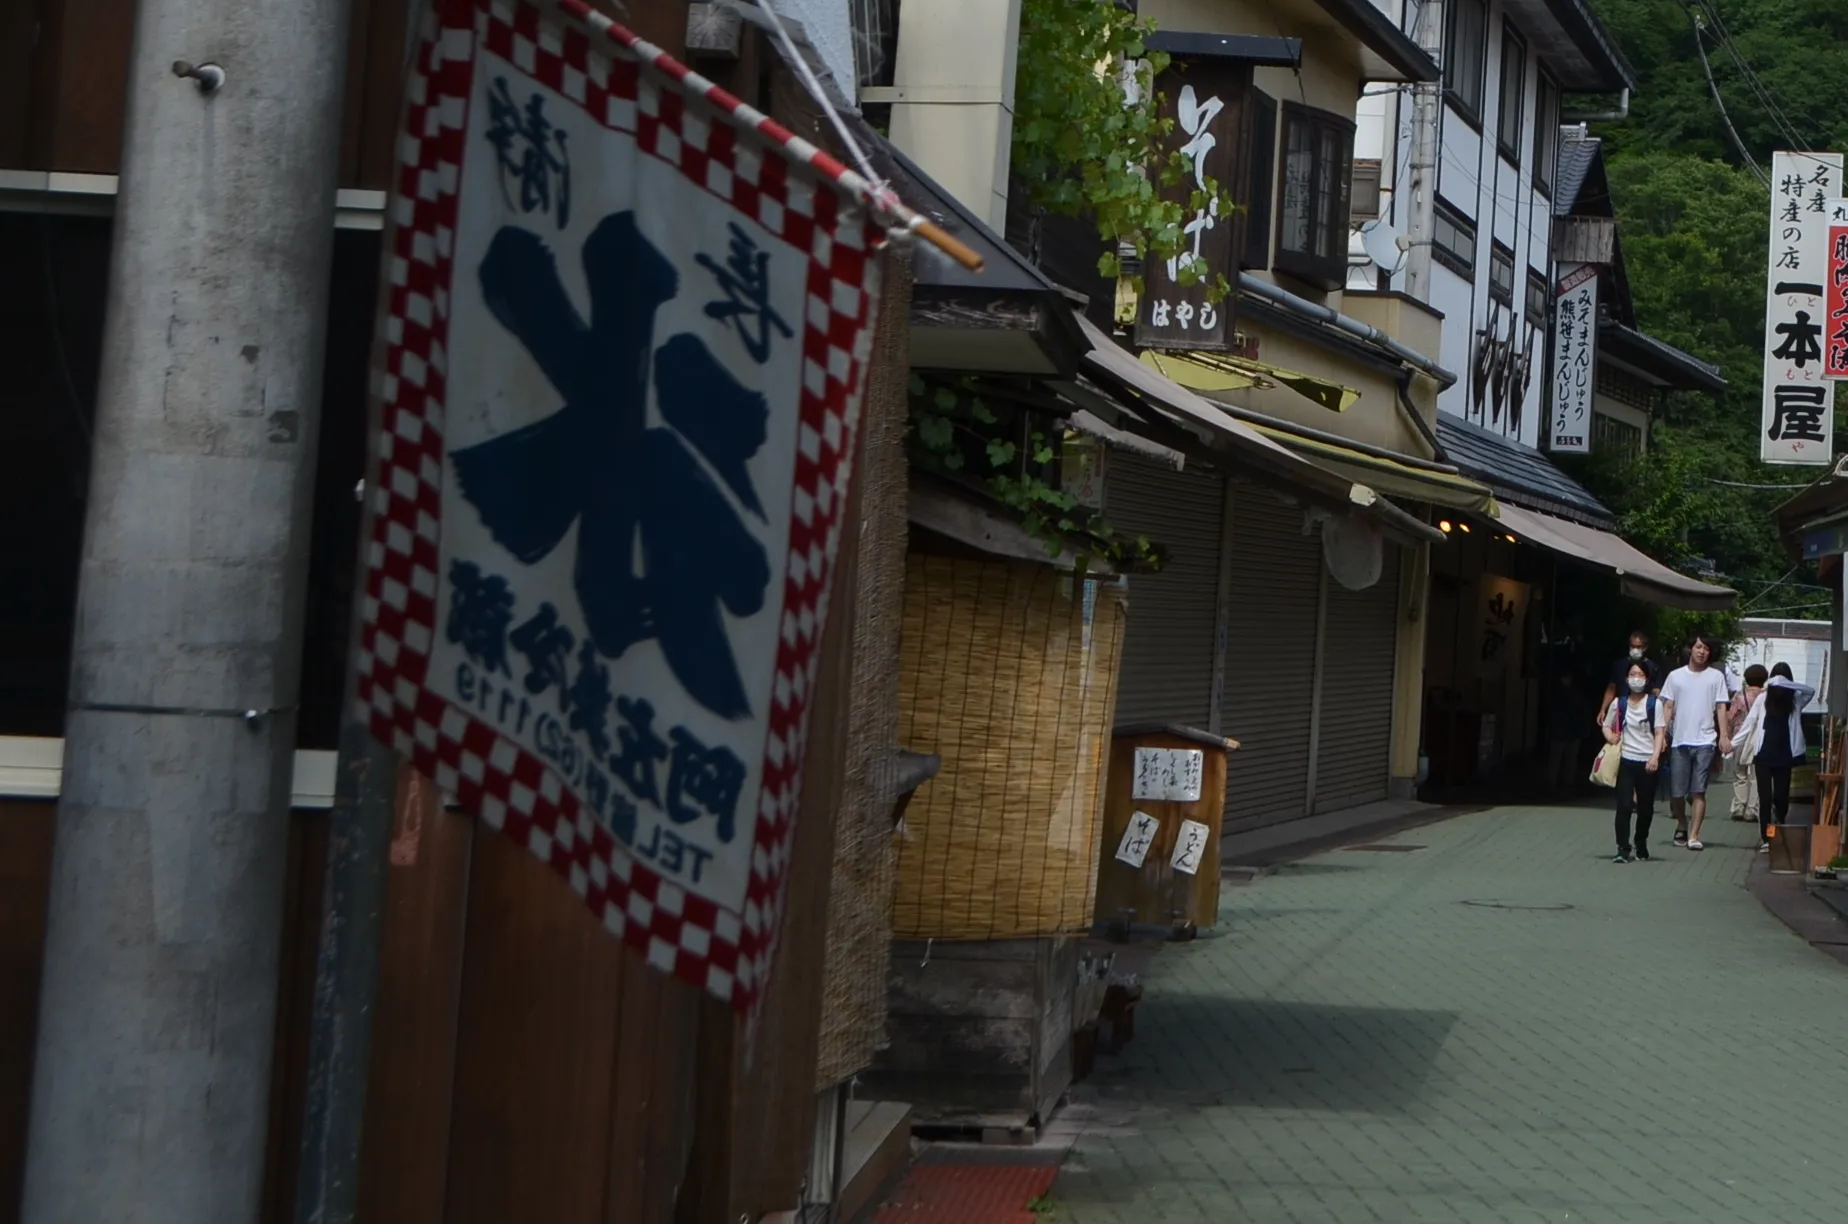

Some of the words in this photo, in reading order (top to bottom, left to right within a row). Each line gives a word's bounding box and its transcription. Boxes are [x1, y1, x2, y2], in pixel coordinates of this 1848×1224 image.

[1776, 174, 1806, 270] 特産の店
[1806, 164, 1831, 213] 名産
[1152, 299, 1217, 330] はやし
[1556, 299, 1576, 433] 熊笹まんじゅう
[1575, 289, 1592, 421] みそまんじゅう
[1768, 281, 1827, 443] 一本屋
[1124, 817, 1152, 855] そば
[1175, 827, 1200, 867] うどん
